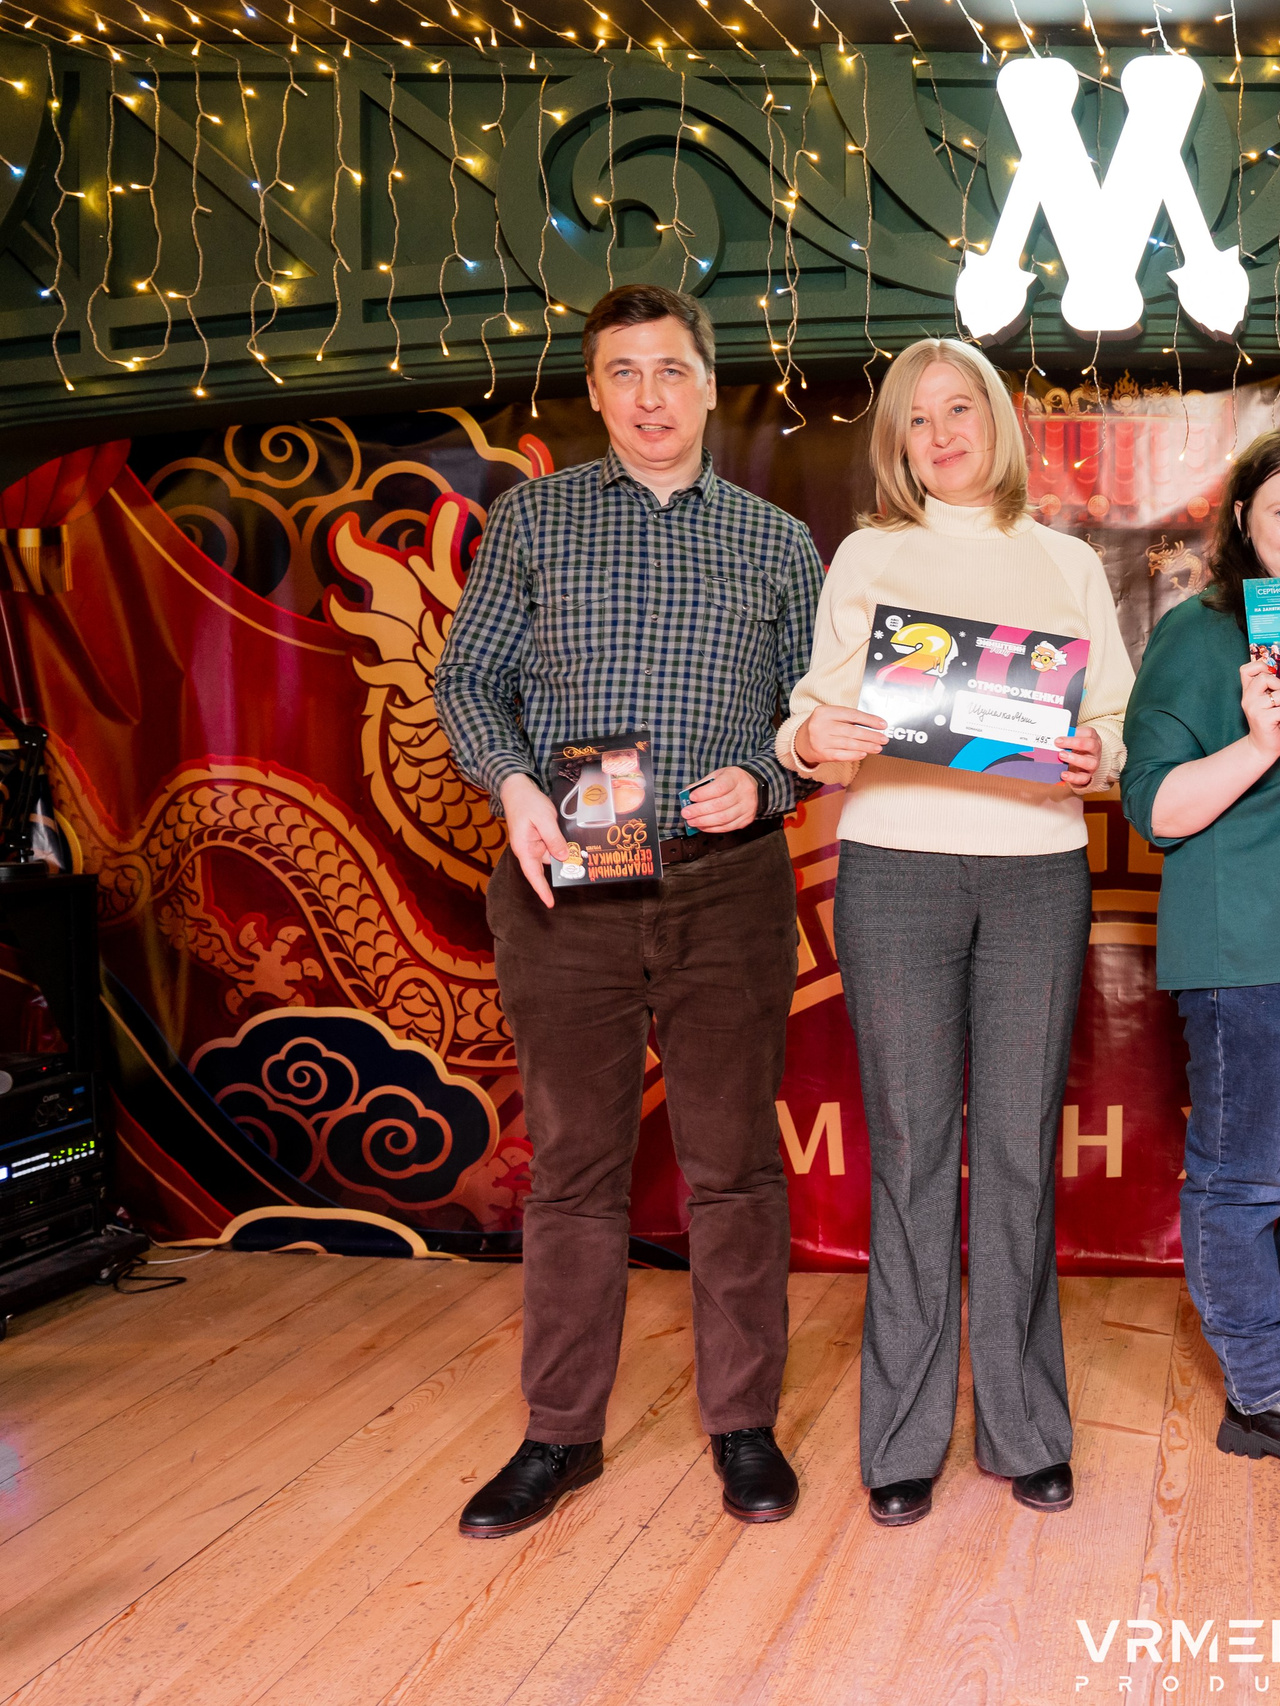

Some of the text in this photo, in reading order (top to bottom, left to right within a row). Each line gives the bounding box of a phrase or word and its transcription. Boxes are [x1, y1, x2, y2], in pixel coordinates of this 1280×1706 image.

[967, 679, 1065, 705] ОТМОРОЖЕНКИ
[606, 821, 648, 845] 250
[587, 848, 653, 866] СЕРТИФИКАТ
[588, 860, 654, 882] ПОДАРОЧНЫЙ
